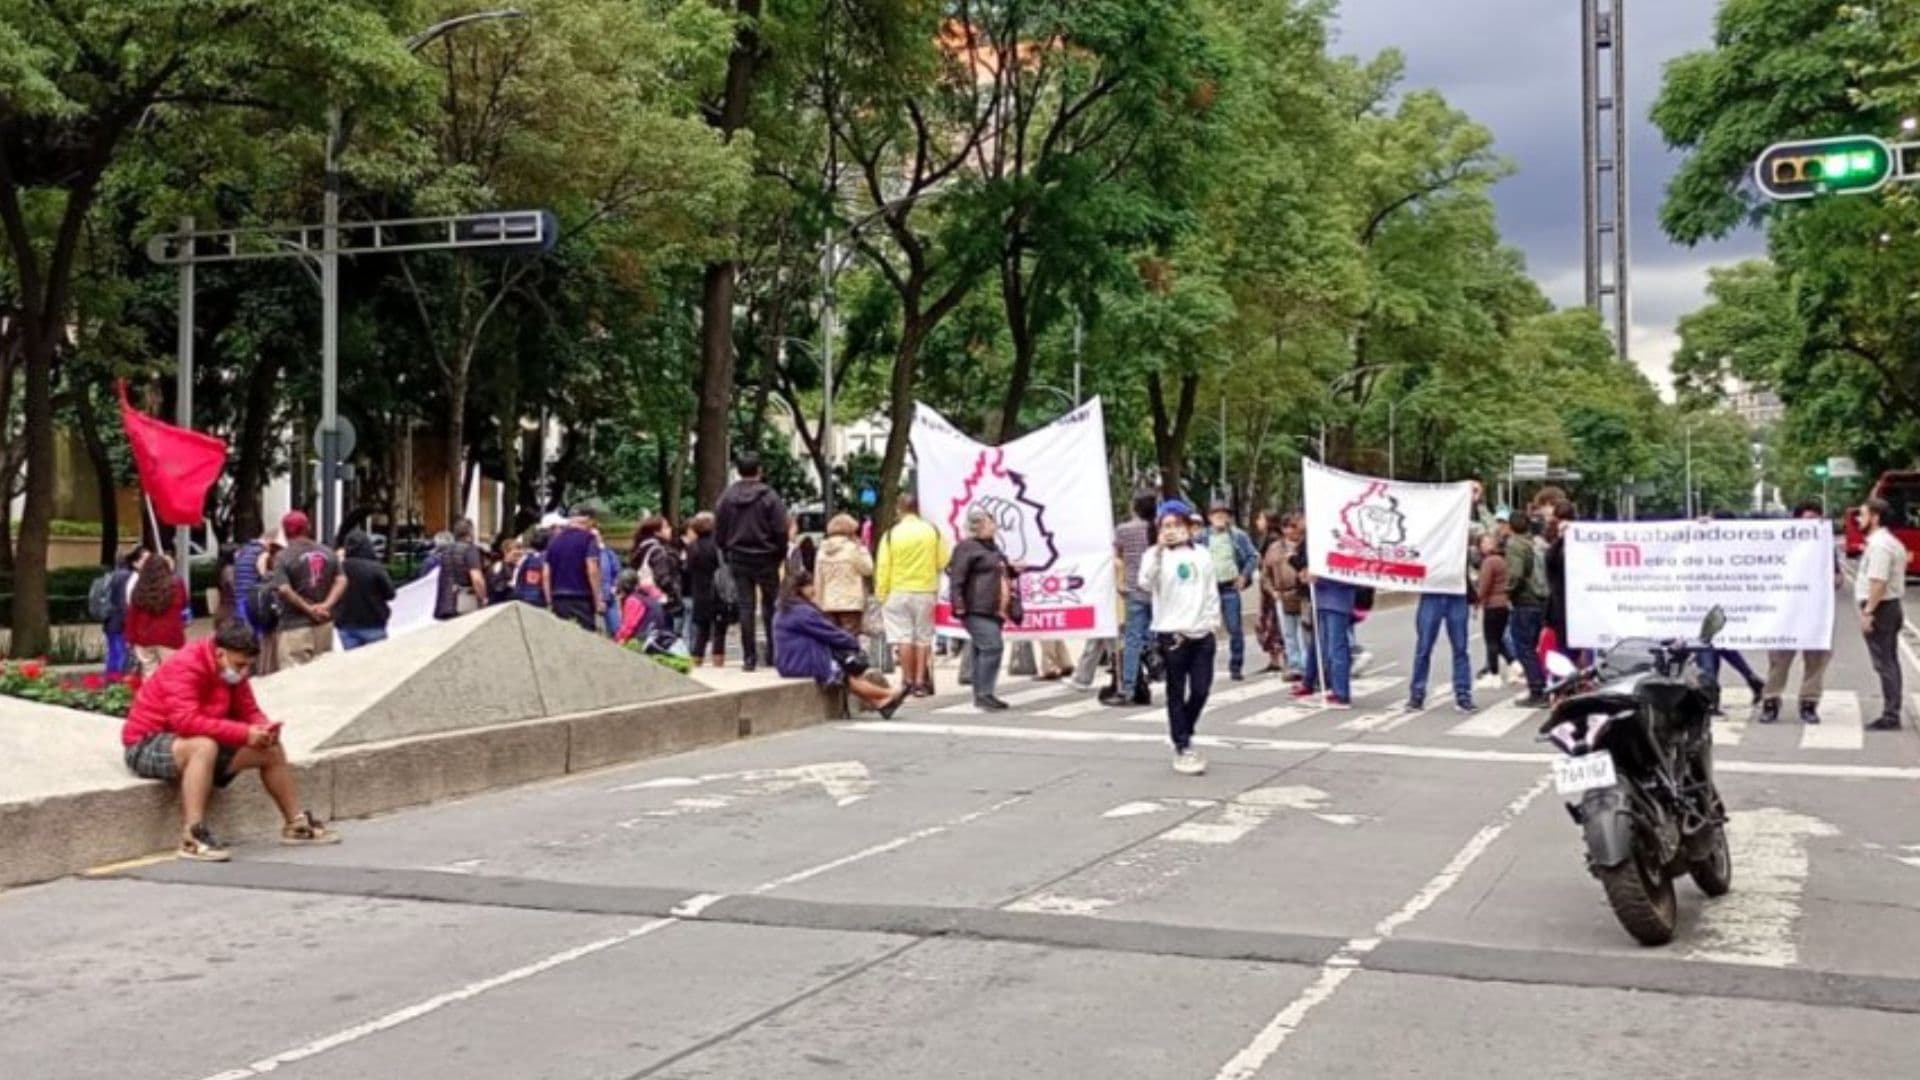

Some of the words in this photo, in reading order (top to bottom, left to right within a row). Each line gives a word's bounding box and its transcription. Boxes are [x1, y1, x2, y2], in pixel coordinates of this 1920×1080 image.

[1574, 528, 1616, 542] Los
[1623, 526, 1775, 544] trabajadores
[1781, 526, 1819, 541] del
[1682, 555, 1704, 567] de
[1708, 555, 1724, 566] la
[1729, 554, 1788, 567] CDMX
